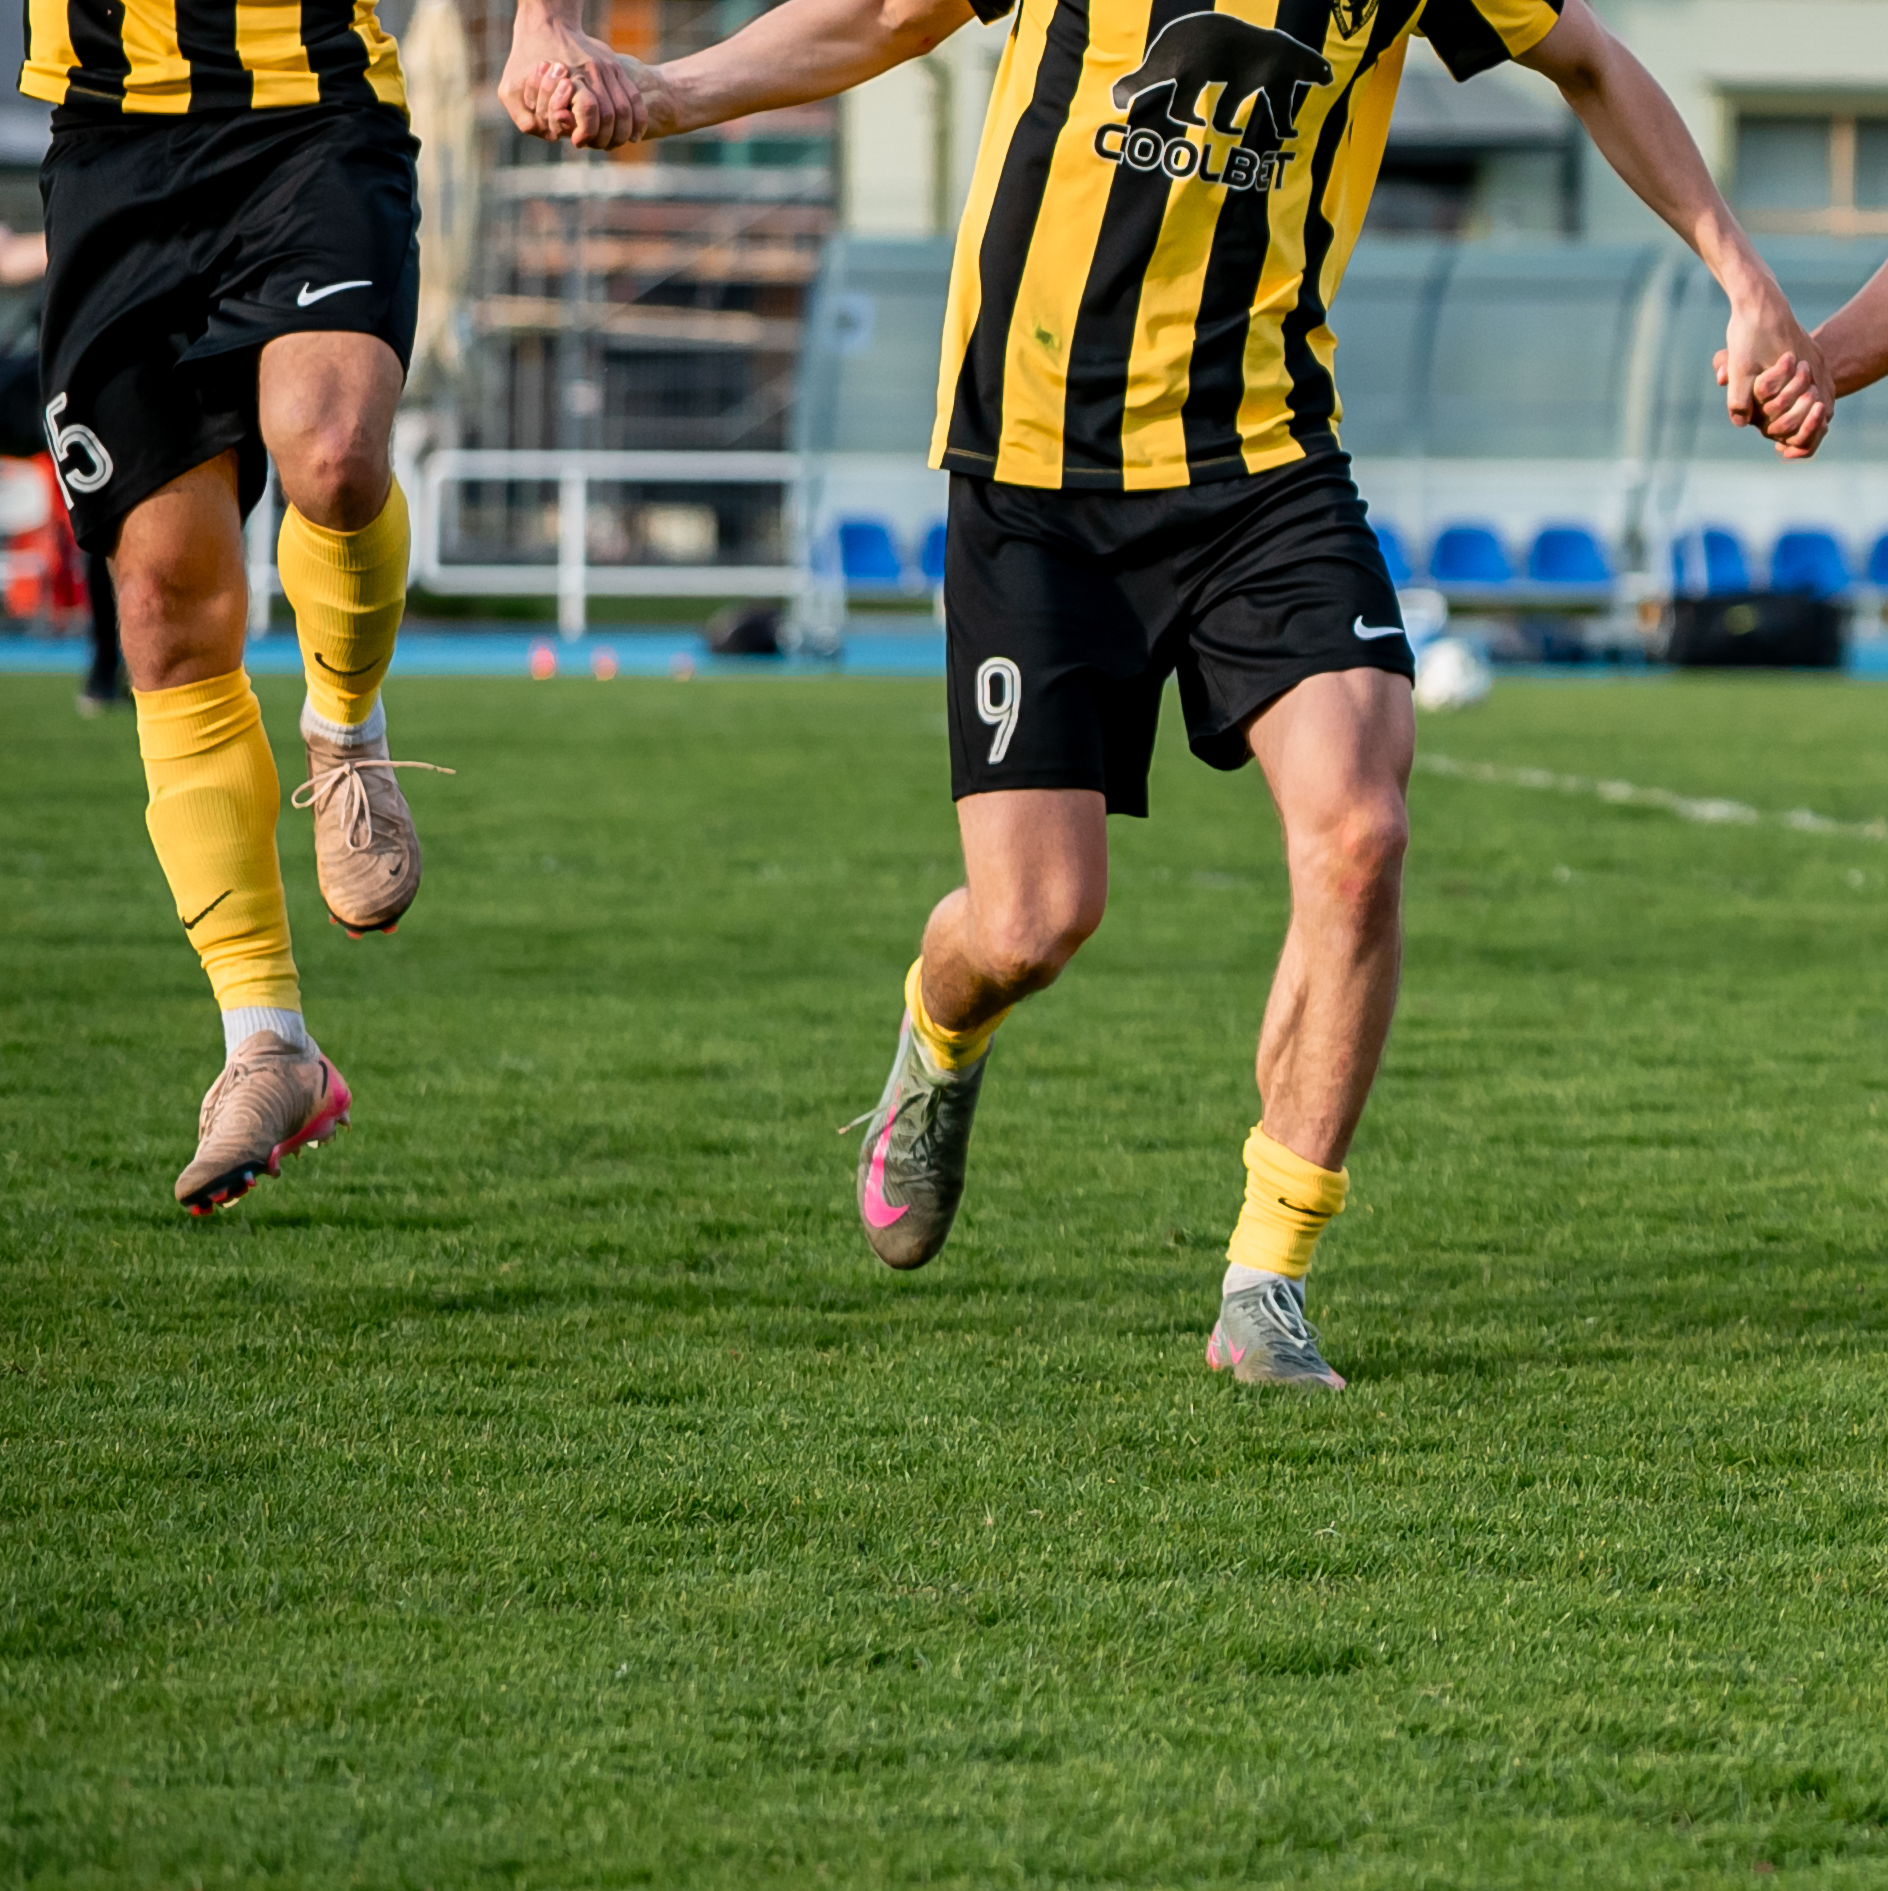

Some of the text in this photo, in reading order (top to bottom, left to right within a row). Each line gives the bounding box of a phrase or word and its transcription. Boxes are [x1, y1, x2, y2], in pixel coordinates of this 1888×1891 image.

[1093, 122, 1297, 192] COOLBET
[43, 391, 114, 511] 5
[976, 656, 1022, 765] 9
